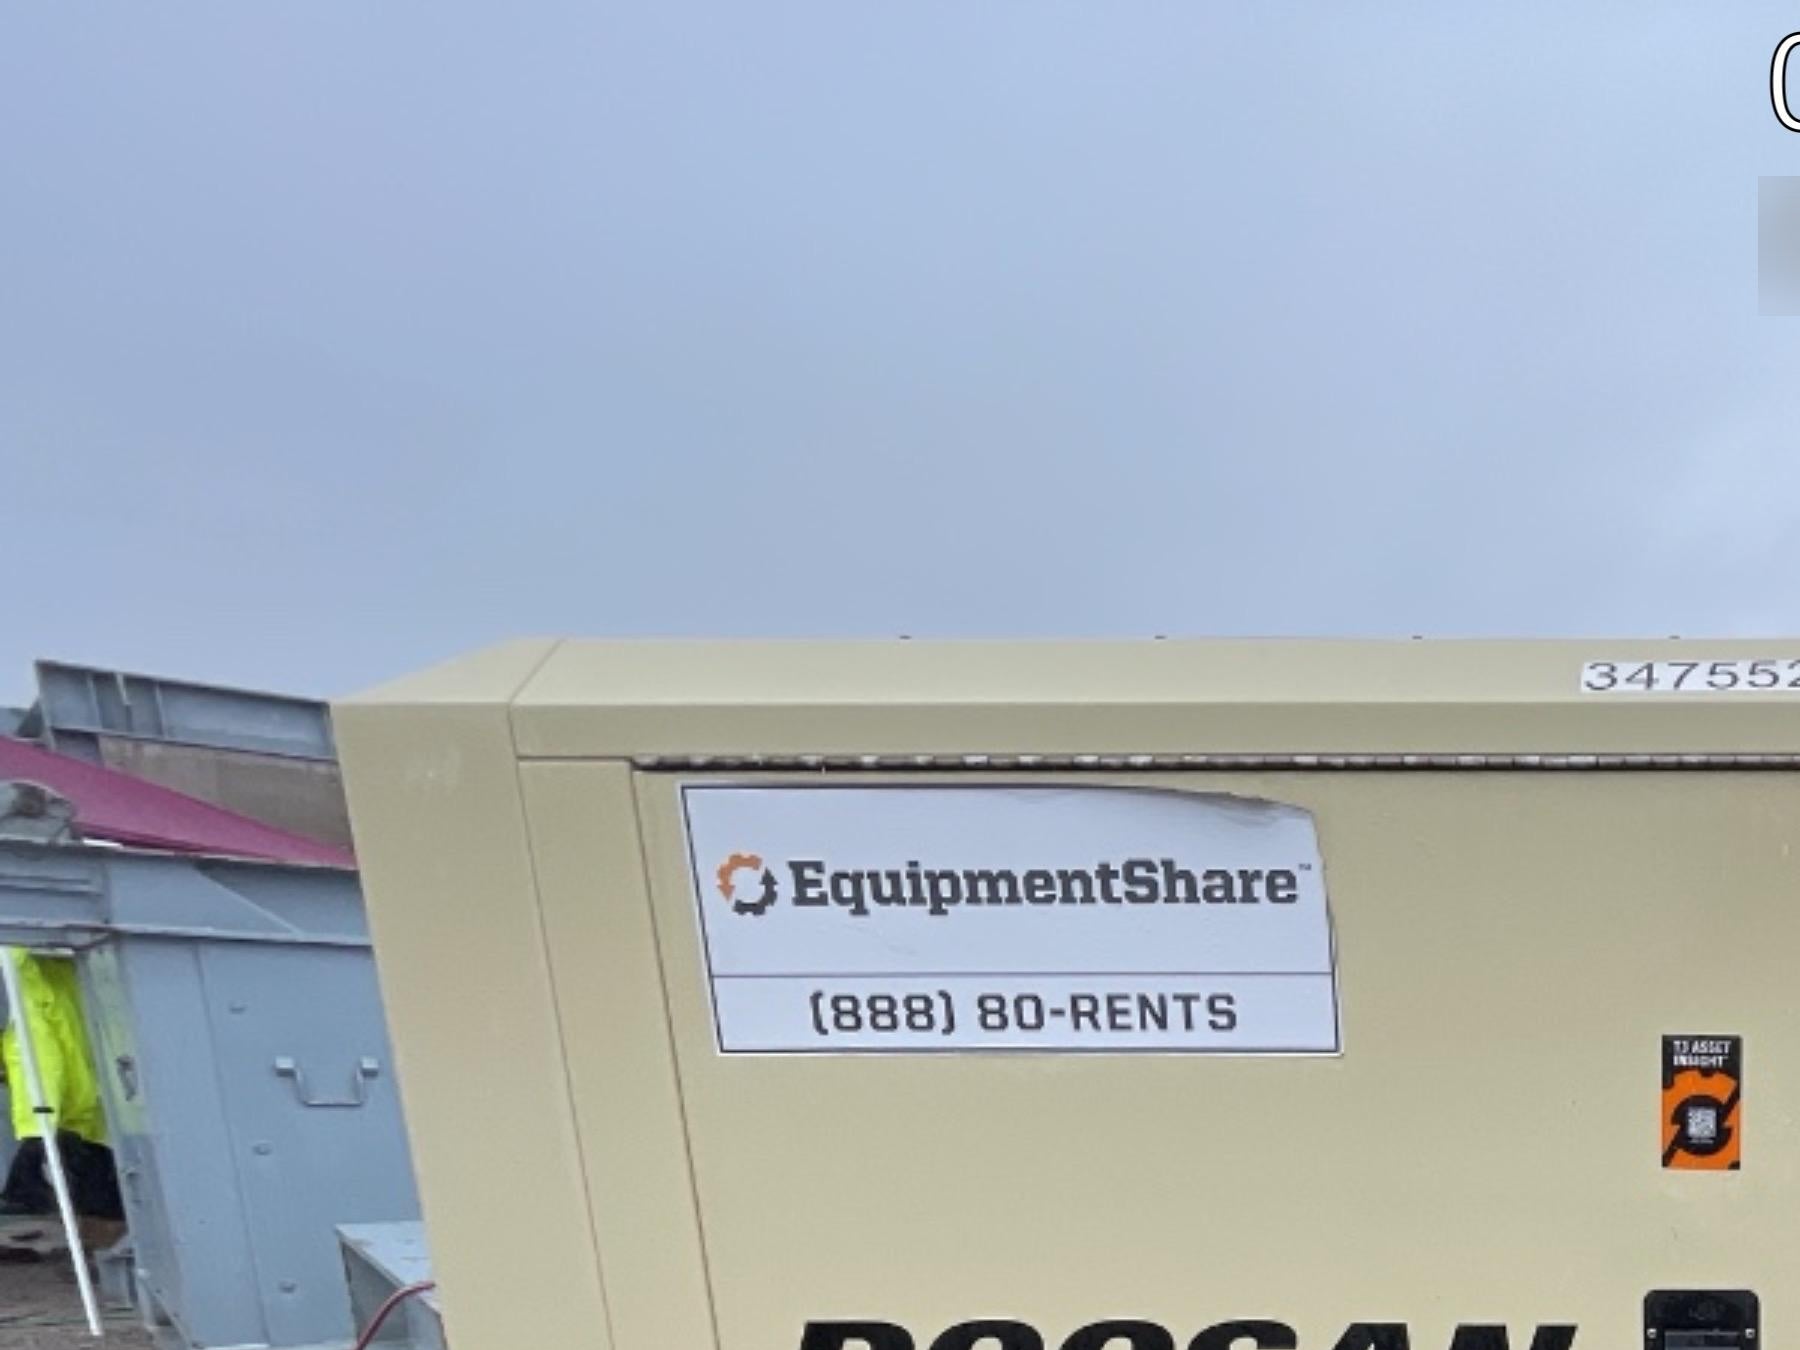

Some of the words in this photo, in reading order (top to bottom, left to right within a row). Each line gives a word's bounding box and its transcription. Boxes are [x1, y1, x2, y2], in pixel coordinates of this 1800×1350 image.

[808, 990, 956, 1035] (888)
[976, 993, 1237, 1031] 80-RENTS
[1692, 1040, 1731, 1053] ASSET
